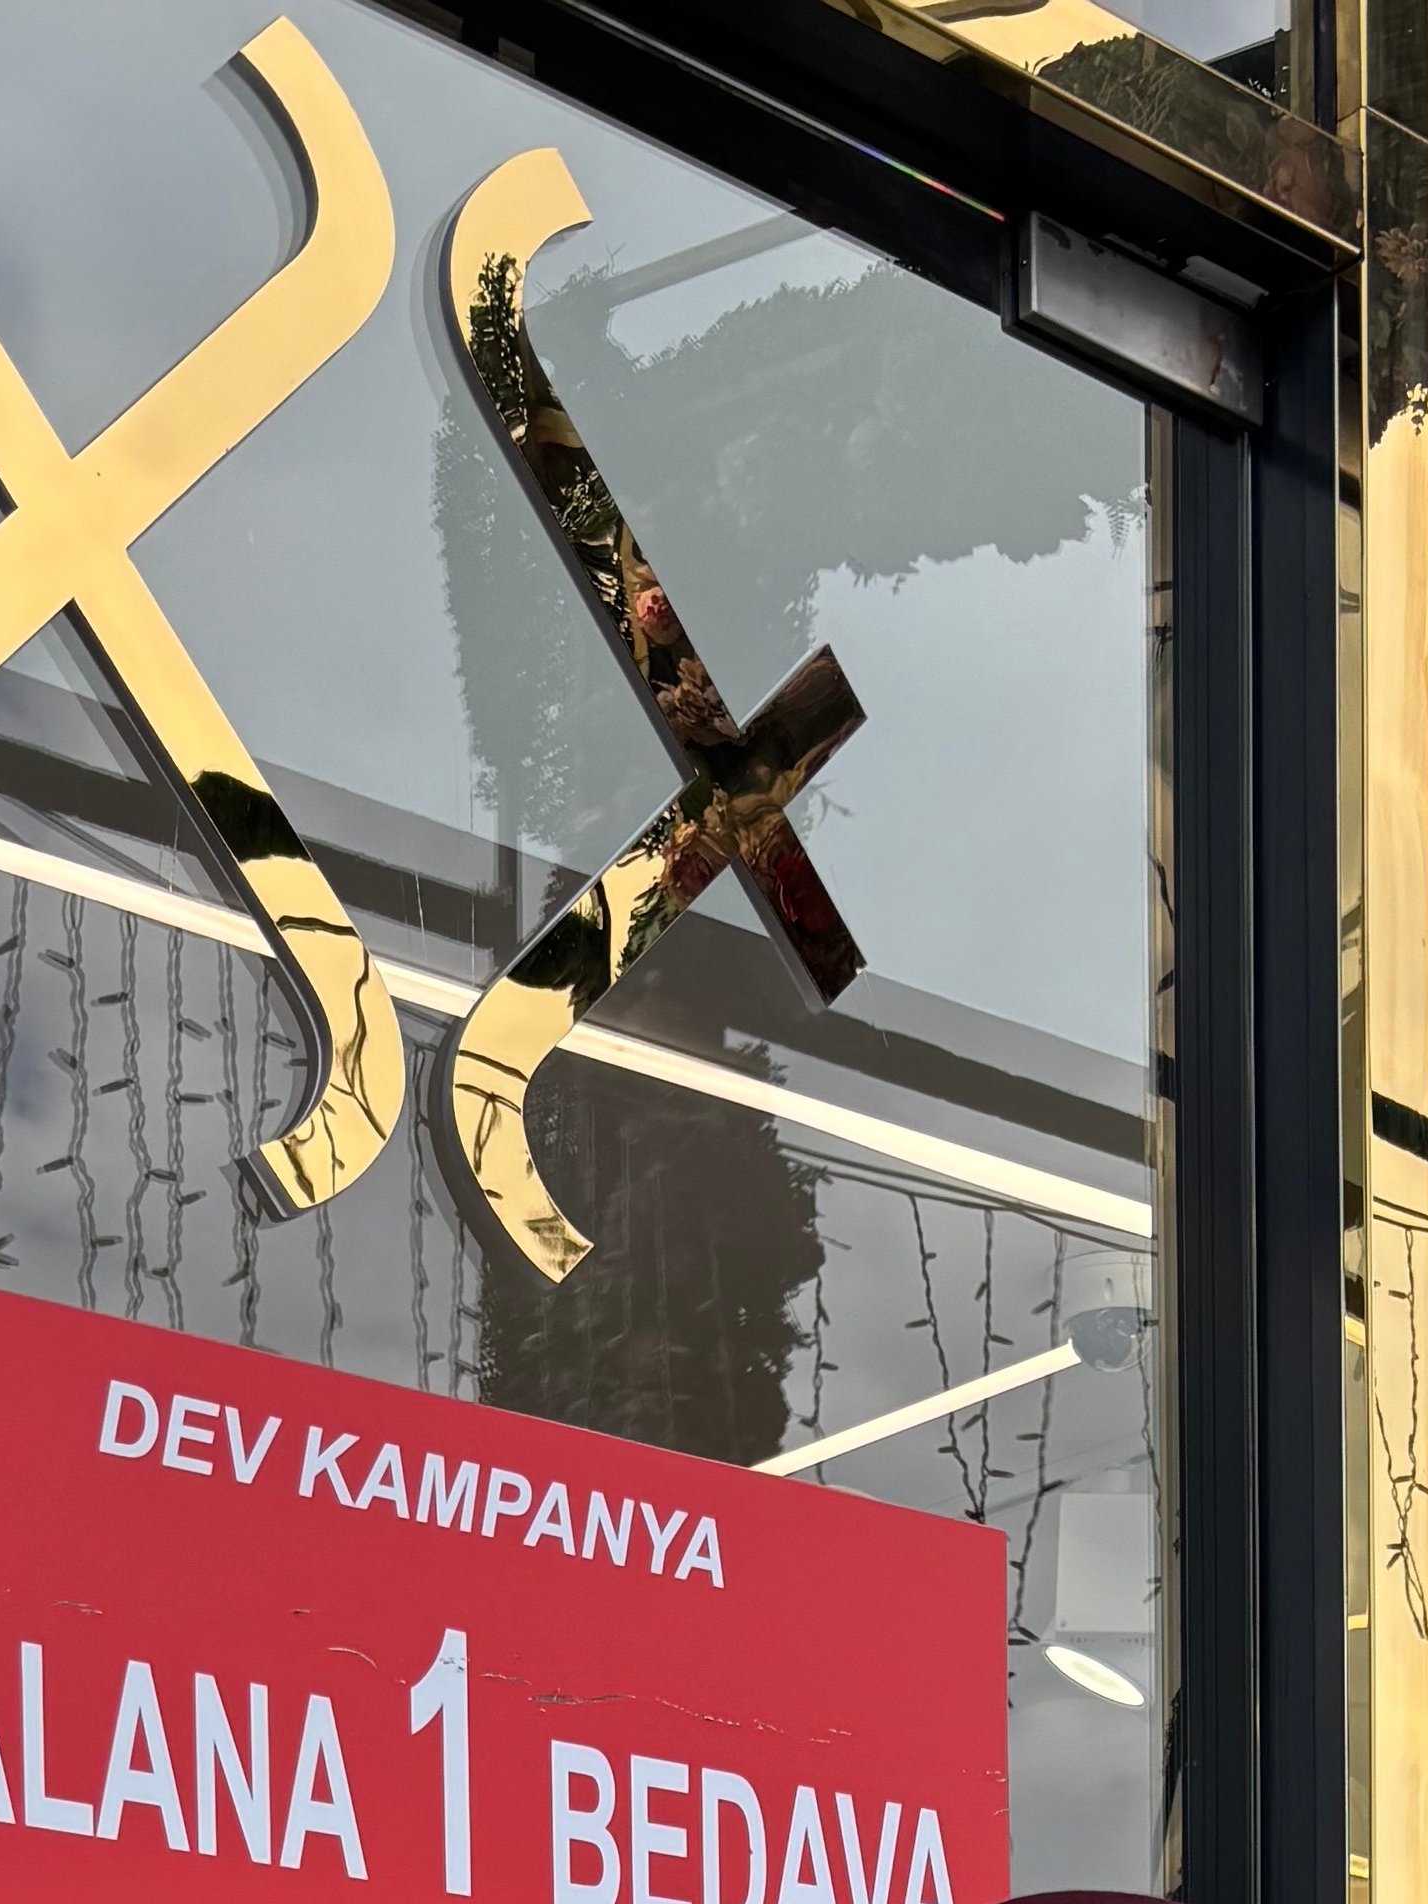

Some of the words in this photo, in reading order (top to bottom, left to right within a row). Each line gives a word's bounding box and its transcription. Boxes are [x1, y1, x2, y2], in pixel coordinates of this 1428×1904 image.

[98, 1379, 283, 1485] DEV
[297, 1425, 725, 1590] KAMPANYA
[409, 1628, 473, 1898] 1
